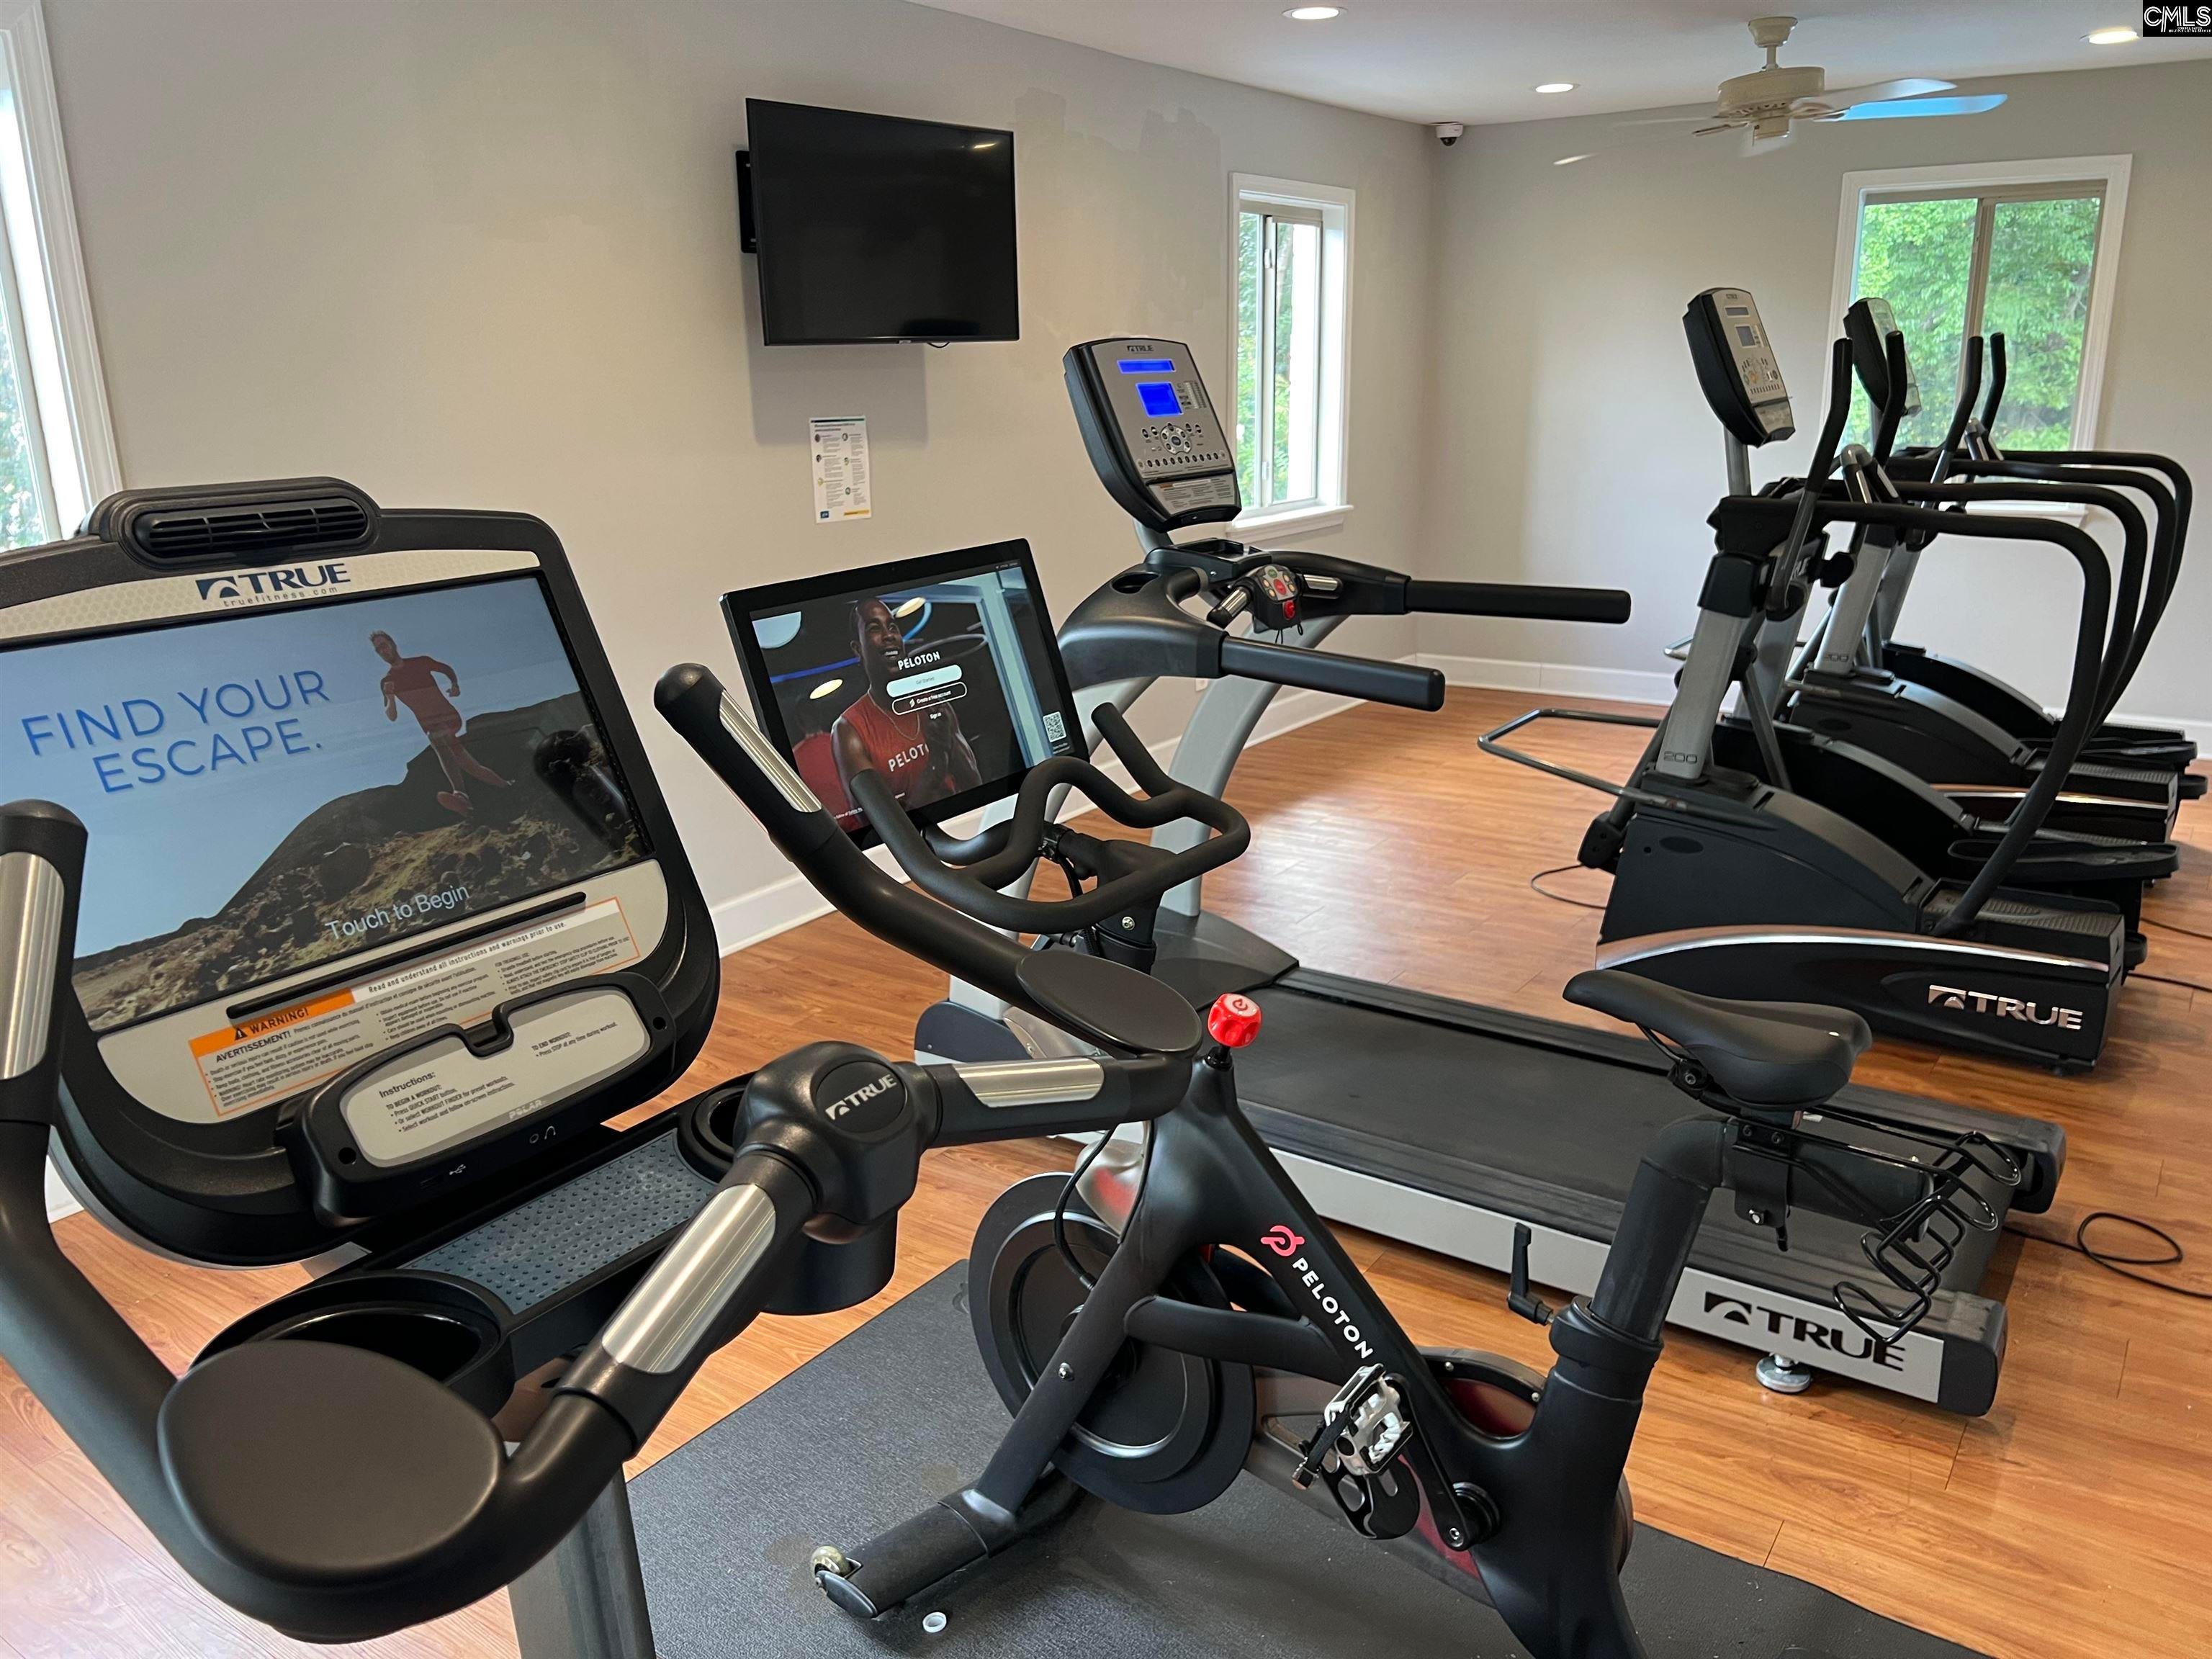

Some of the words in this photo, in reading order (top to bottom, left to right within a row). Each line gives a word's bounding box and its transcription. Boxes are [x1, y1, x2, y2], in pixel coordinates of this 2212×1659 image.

[238, 563, 351, 593] TRUE
[223, 586, 338, 607] truefitness.com
[897, 651, 940, 670] PELOTON
[22, 698, 165, 756] FIND
[177, 670, 330, 725] YOUR
[92, 717, 322, 792] ESCAPE.
[325, 908, 390, 940] Touch
[393, 904, 413, 920] to
[415, 884, 470, 914] Begin
[368, 981, 386, 993] Read
[386, 977, 400, 987] and
[400, 964, 437, 982] understand
[437, 961, 447, 969] all
[448, 947, 487, 966] instructions
[488, 943, 500, 952] and
[500, 934, 529, 948] warnings
[529, 928, 545, 939] prior
[553, 921, 567, 930] use.
[249, 1007, 309, 1034] WARNING!
[1968, 991, 2083, 1030] TRUE
[215, 1030, 291, 1062] AVERTISSEMENT!
[378, 1071, 436, 1098] Instructions:
[844, 1074, 897, 1106] TRUE
[508, 1100, 542, 1120] POLAR
[1292, 1256, 1373, 1359] PELOTON
[1756, 1305, 1907, 1372] TRUE
